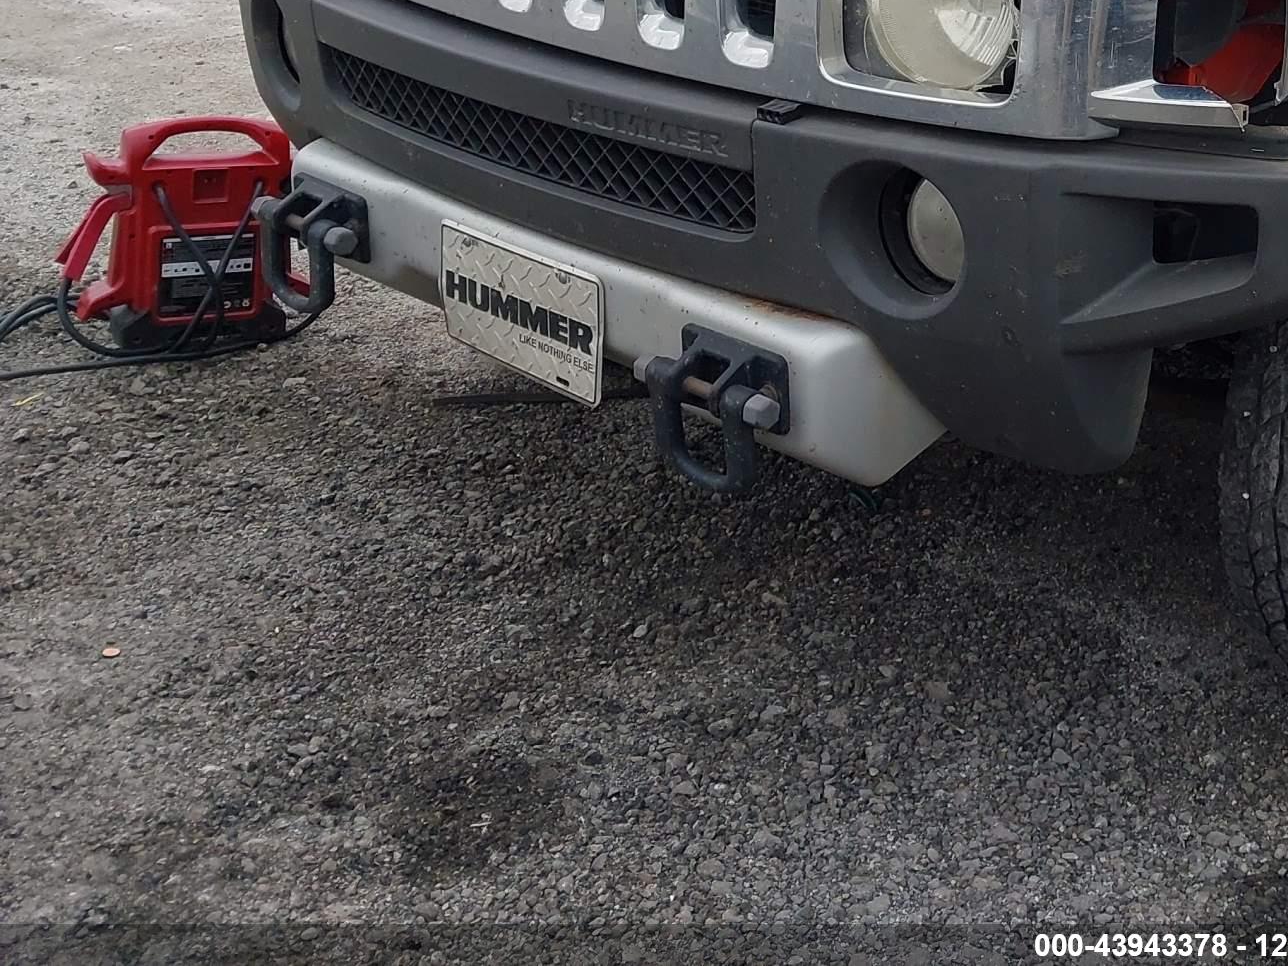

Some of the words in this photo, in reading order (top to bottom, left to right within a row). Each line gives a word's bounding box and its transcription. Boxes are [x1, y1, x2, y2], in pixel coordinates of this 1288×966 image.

[566, 97, 730, 157] HUMMER
[446, 270, 593, 356] HUMMER
[519, 334, 537, 349] LIKE
[538, 339, 572, 363] NOTHING
[573, 356, 594, 373] ELSE
